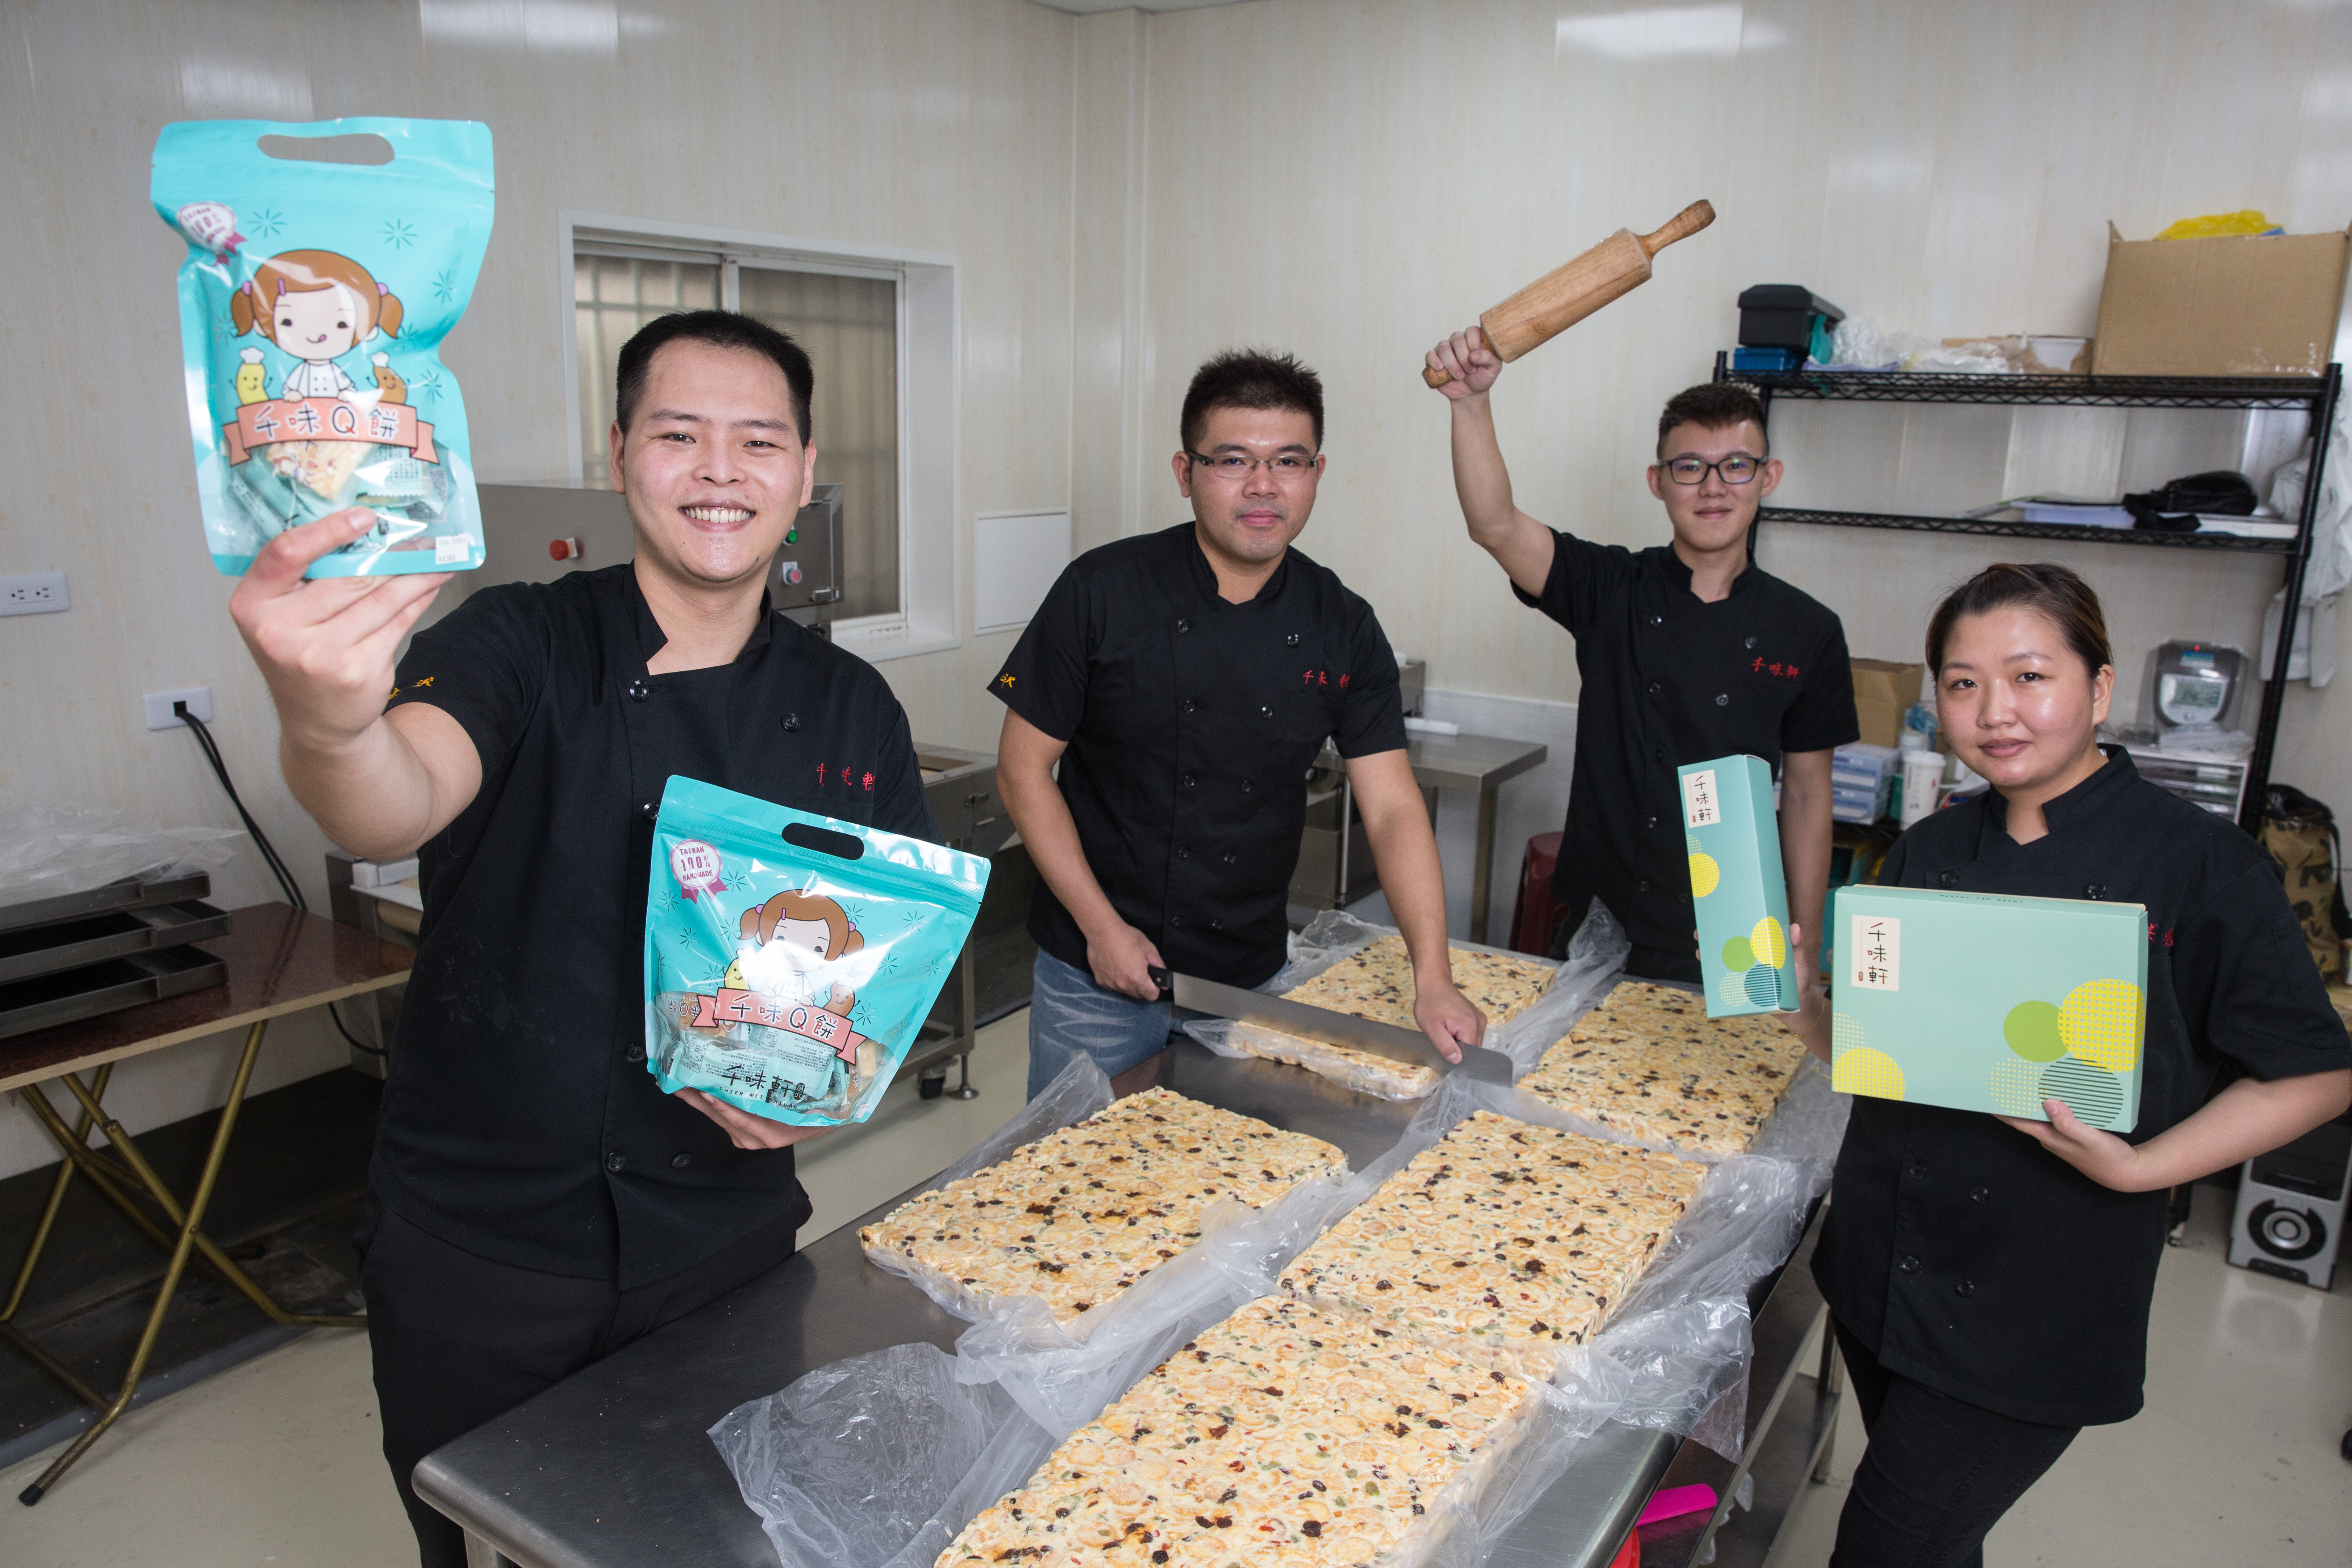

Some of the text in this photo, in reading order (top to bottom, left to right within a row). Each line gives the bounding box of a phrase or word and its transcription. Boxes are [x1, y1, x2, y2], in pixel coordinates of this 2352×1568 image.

[255, 403, 398, 439] 千味Q餅
[1694, 775, 1712, 822] 千味軒
[679, 846, 704, 855] TAIWAN
[681, 855, 710, 871] 100%
[682, 870, 713, 882] HANDMADE
[1867, 922, 1889, 985] 千味軒
[730, 994, 837, 1039] 千味Q餅
[722, 1065, 793, 1097] 千味軒
[719, 1087, 744, 1096] CHIEN
[769, 1098, 798, 1110] SHIUAN
